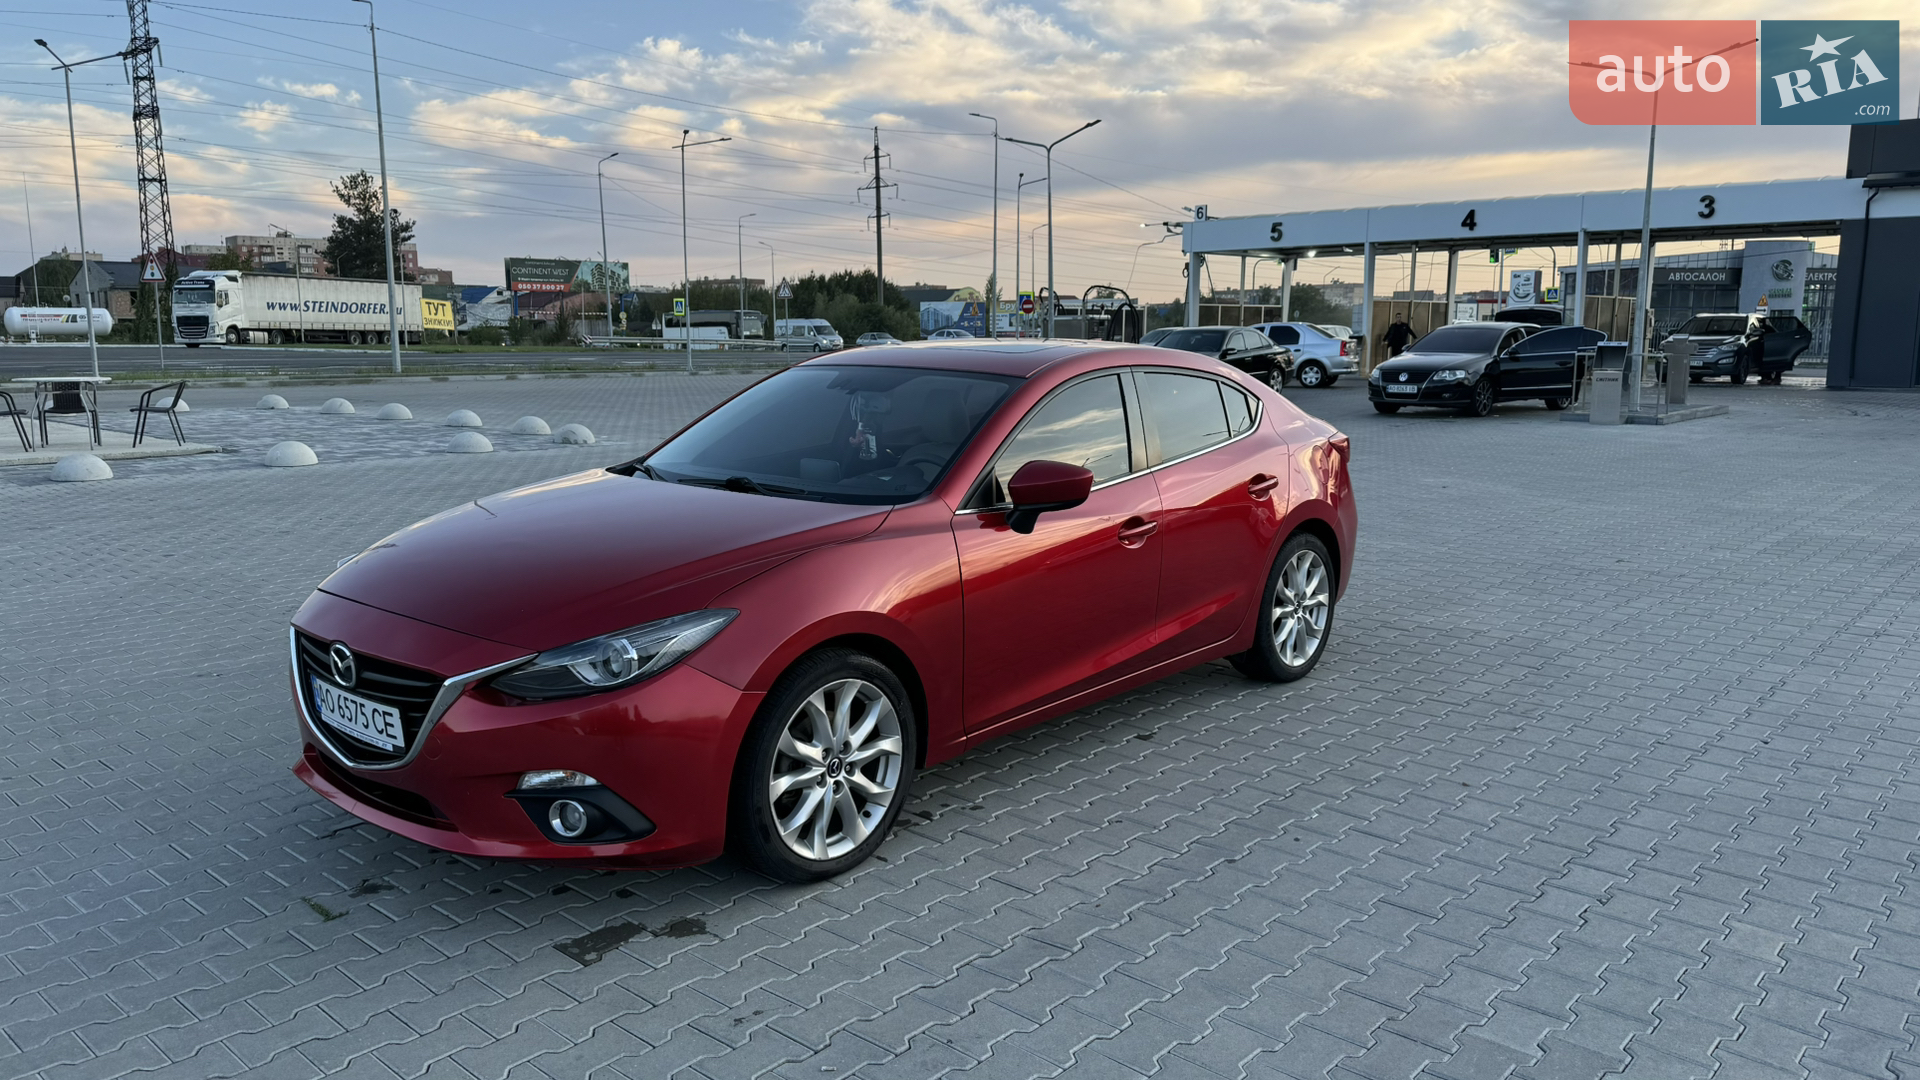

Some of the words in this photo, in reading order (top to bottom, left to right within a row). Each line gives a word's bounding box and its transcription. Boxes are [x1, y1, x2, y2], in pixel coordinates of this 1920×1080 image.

[1196, 206, 1204, 220] 6
[1698, 194, 1715, 219] 3
[1461, 209, 1477, 231] 4
[1270, 222, 1283, 242] 5
[511, 266, 552, 275] CONTINENT
[552, 268, 569, 276] WEST
[1668, 272, 1726, 281] АВТОСАЛОН
[266, 299, 402, 315] www.STEINDORFER.u
[425, 301, 446, 317] ТУТ
[319, 684, 335, 714] AO
[338, 694, 369, 730] 6575
[372, 708, 398, 740] CE
